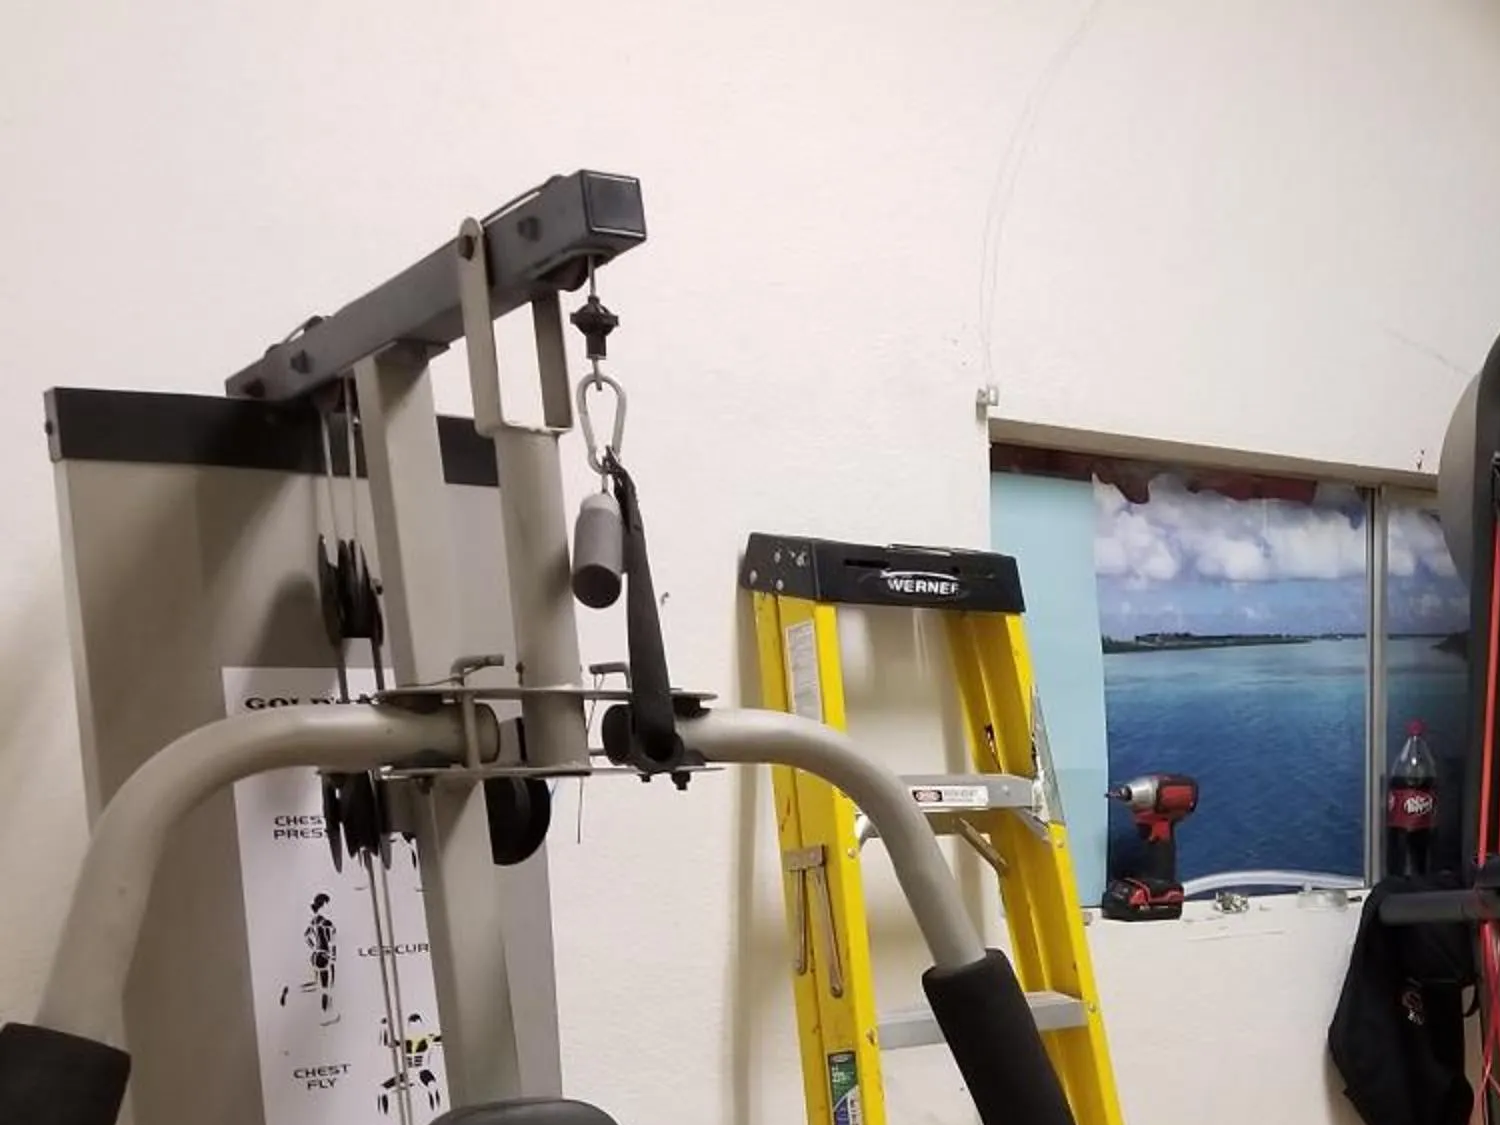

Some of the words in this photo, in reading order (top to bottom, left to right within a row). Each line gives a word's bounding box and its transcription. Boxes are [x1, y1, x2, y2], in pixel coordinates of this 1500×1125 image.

[274, 815, 325, 826] CHES
[273, 828, 328, 840] PRES
[395, 942, 429, 954] CUR
[293, 1063, 351, 1079] CHEST
[306, 1077, 337, 1090] FLY
